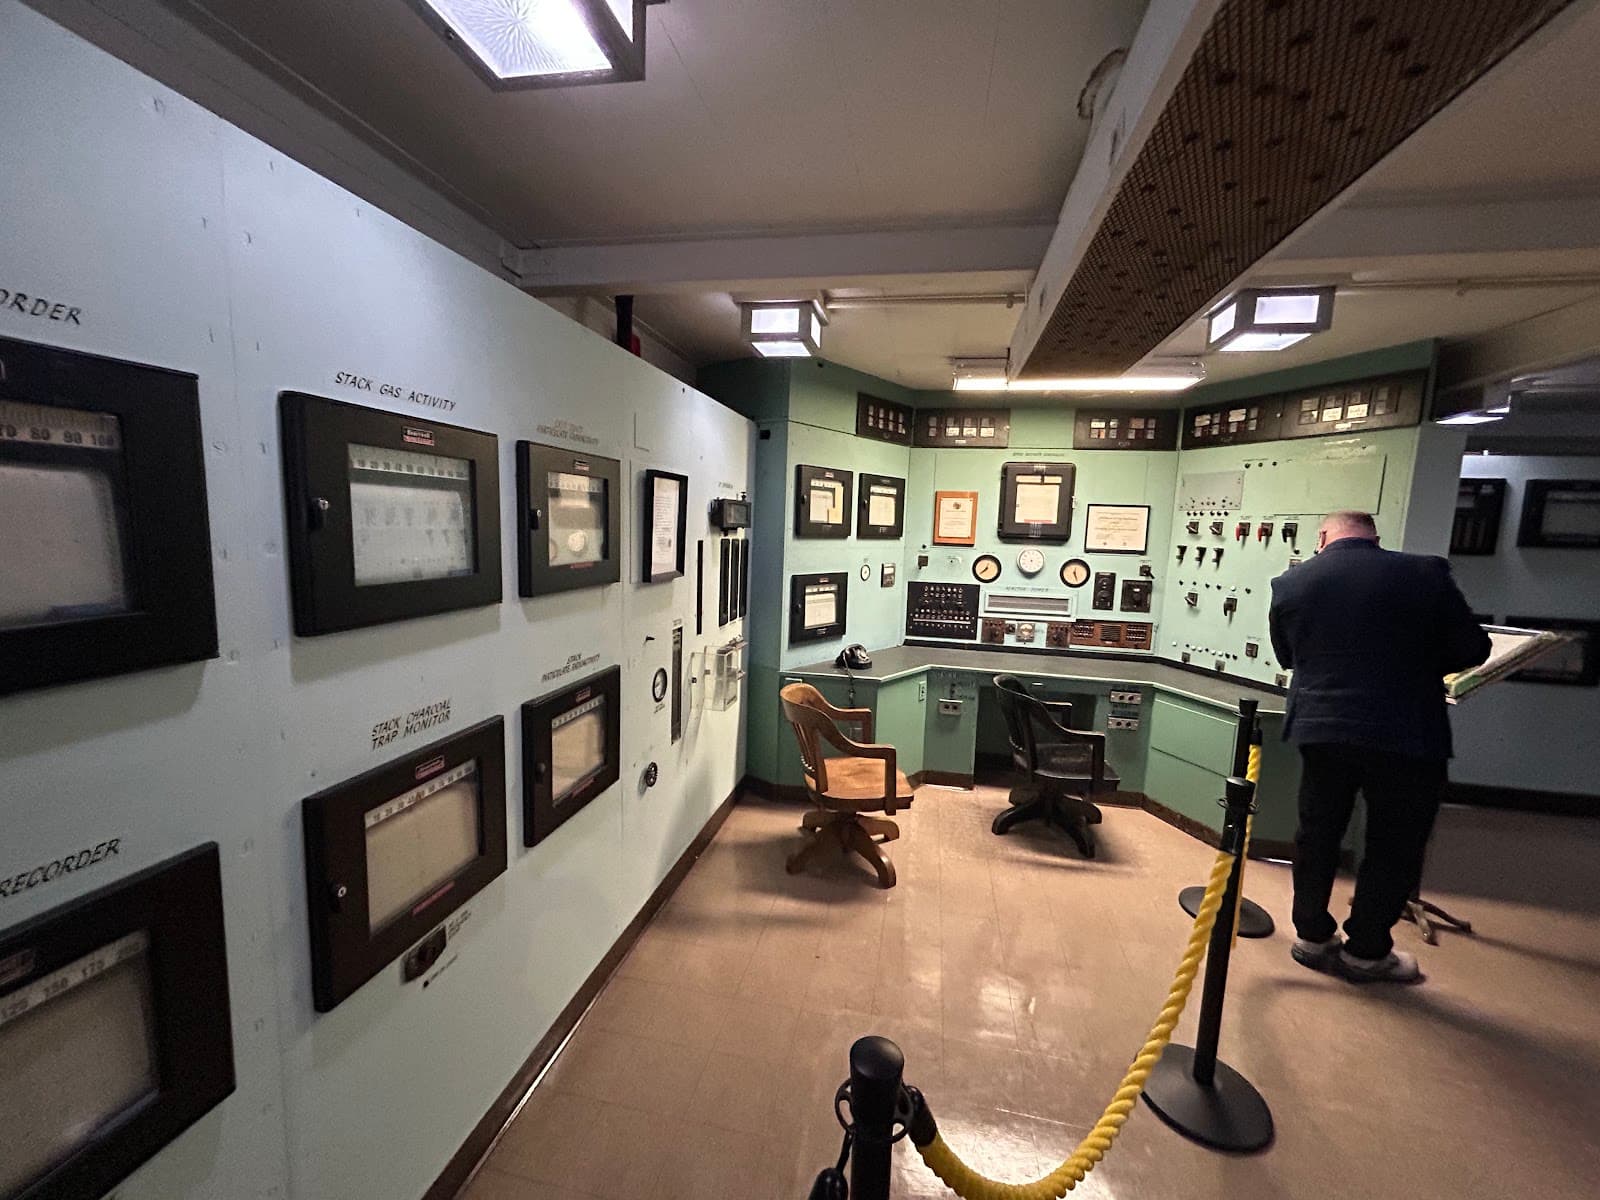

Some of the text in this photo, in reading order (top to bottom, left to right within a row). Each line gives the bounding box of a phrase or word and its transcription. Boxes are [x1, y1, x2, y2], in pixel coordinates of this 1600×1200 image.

[335, 371, 457, 412] STACK GAS ACTIVITY
[371, 699, 452, 737] STACK CHARCOAL
[371, 710, 451, 752] TRAP MONITOR
[0, 838, 121, 898] RECORDER
